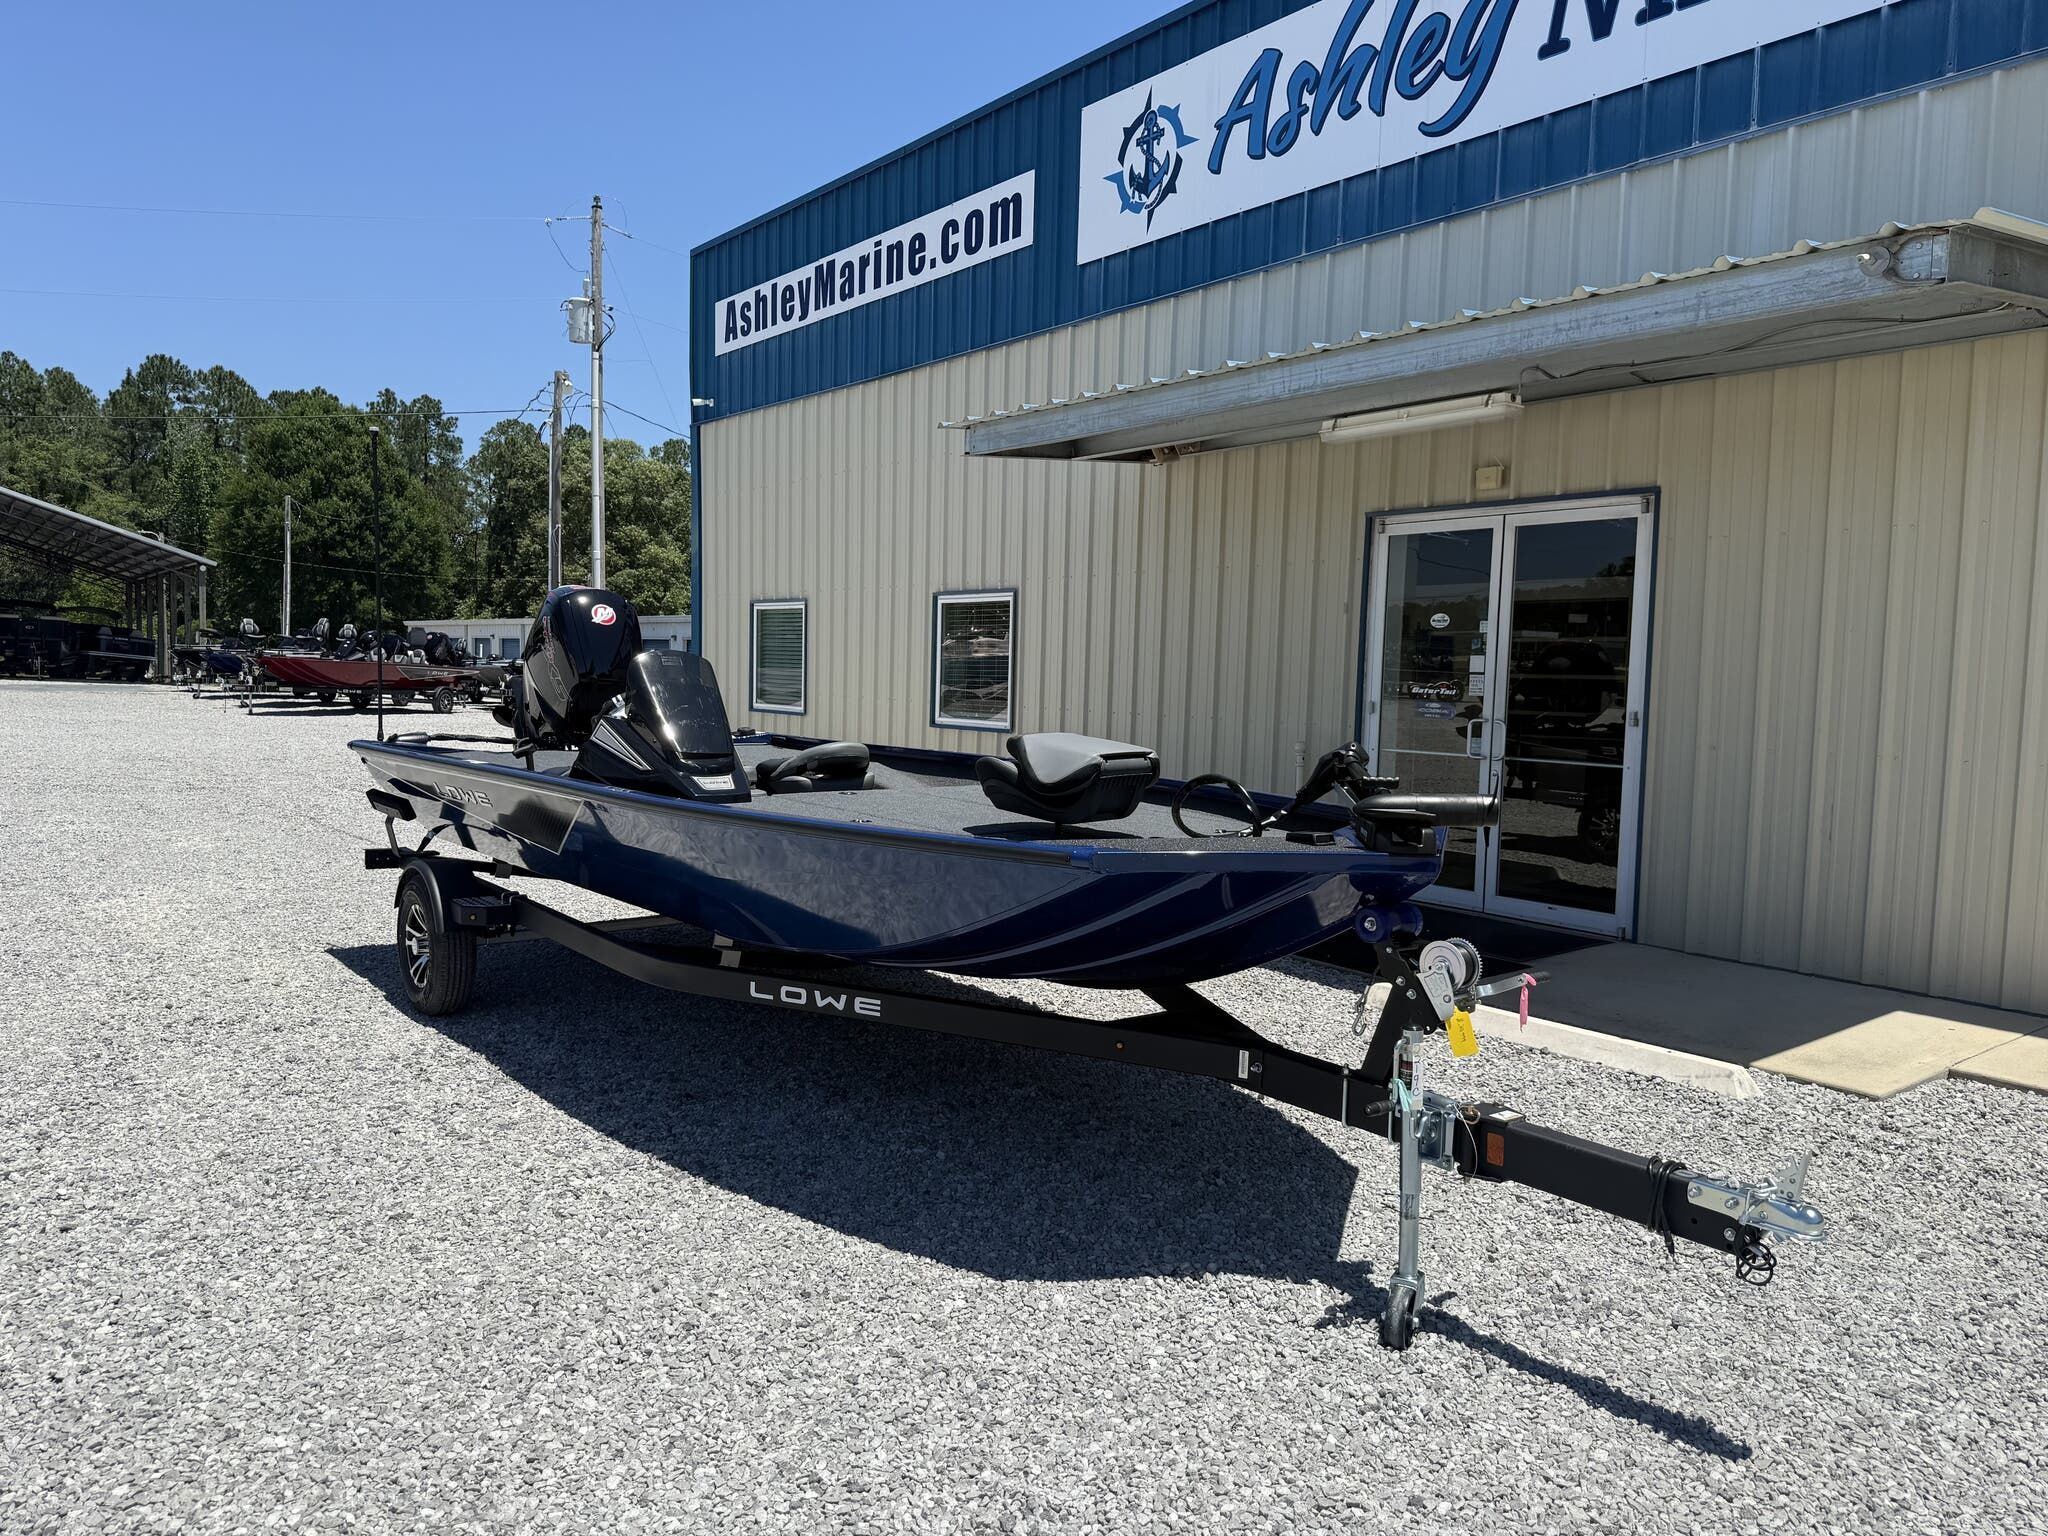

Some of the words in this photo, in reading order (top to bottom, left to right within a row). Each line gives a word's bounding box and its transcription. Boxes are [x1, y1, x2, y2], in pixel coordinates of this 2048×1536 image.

[1208, 0, 1520, 175] Ashley
[724, 191, 1023, 344] AshleyMarine.com
[432, 780, 494, 808] LOWE
[750, 981, 881, 1017] LOWE
